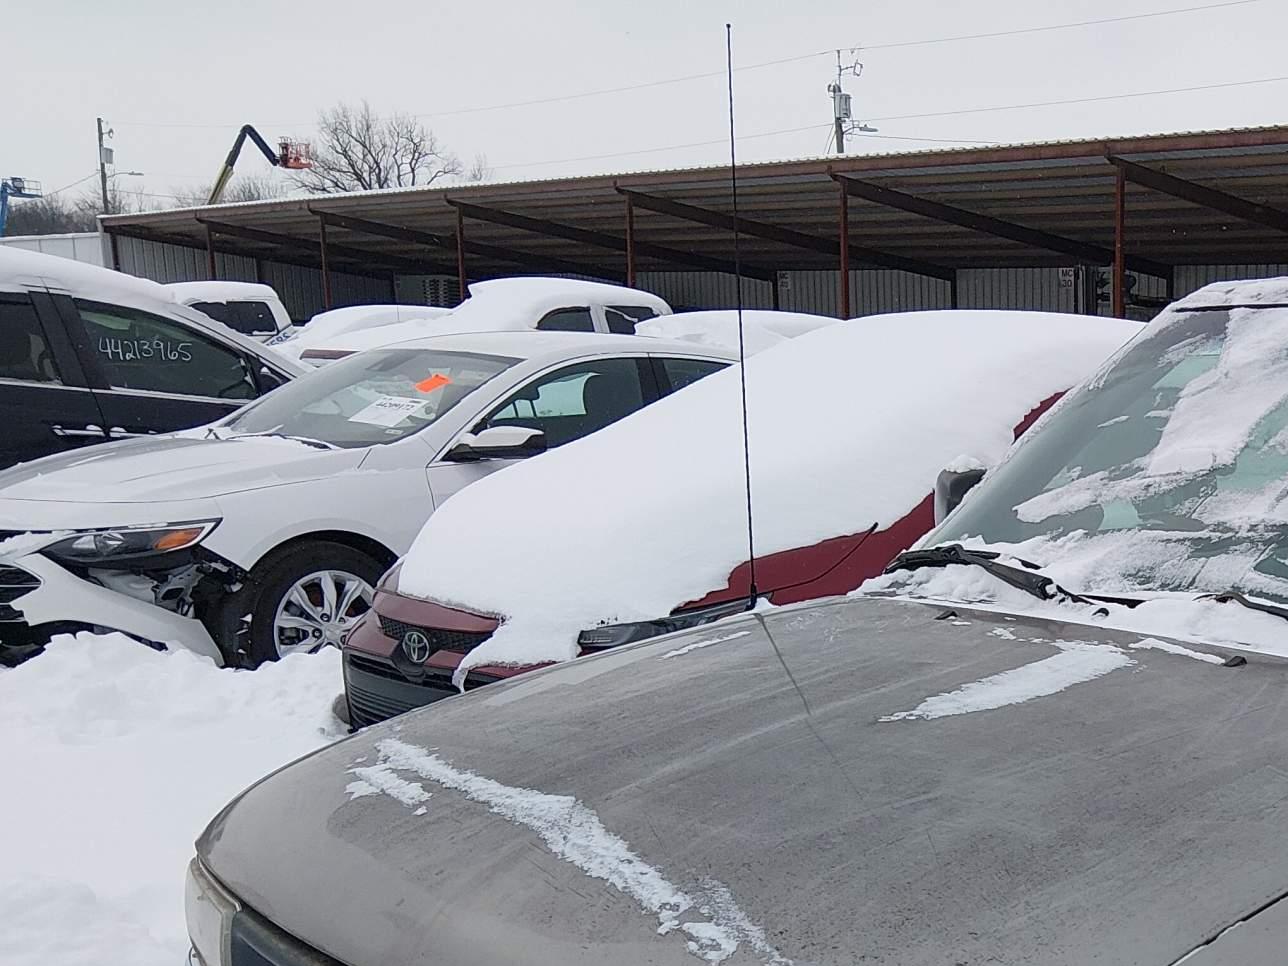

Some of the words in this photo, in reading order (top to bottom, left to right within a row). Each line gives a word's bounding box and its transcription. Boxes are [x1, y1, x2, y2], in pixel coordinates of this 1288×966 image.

[1061, 268, 1073, 278] MC
[1062, 279, 1073, 288] 30
[98, 336, 193, 362] 44213965
